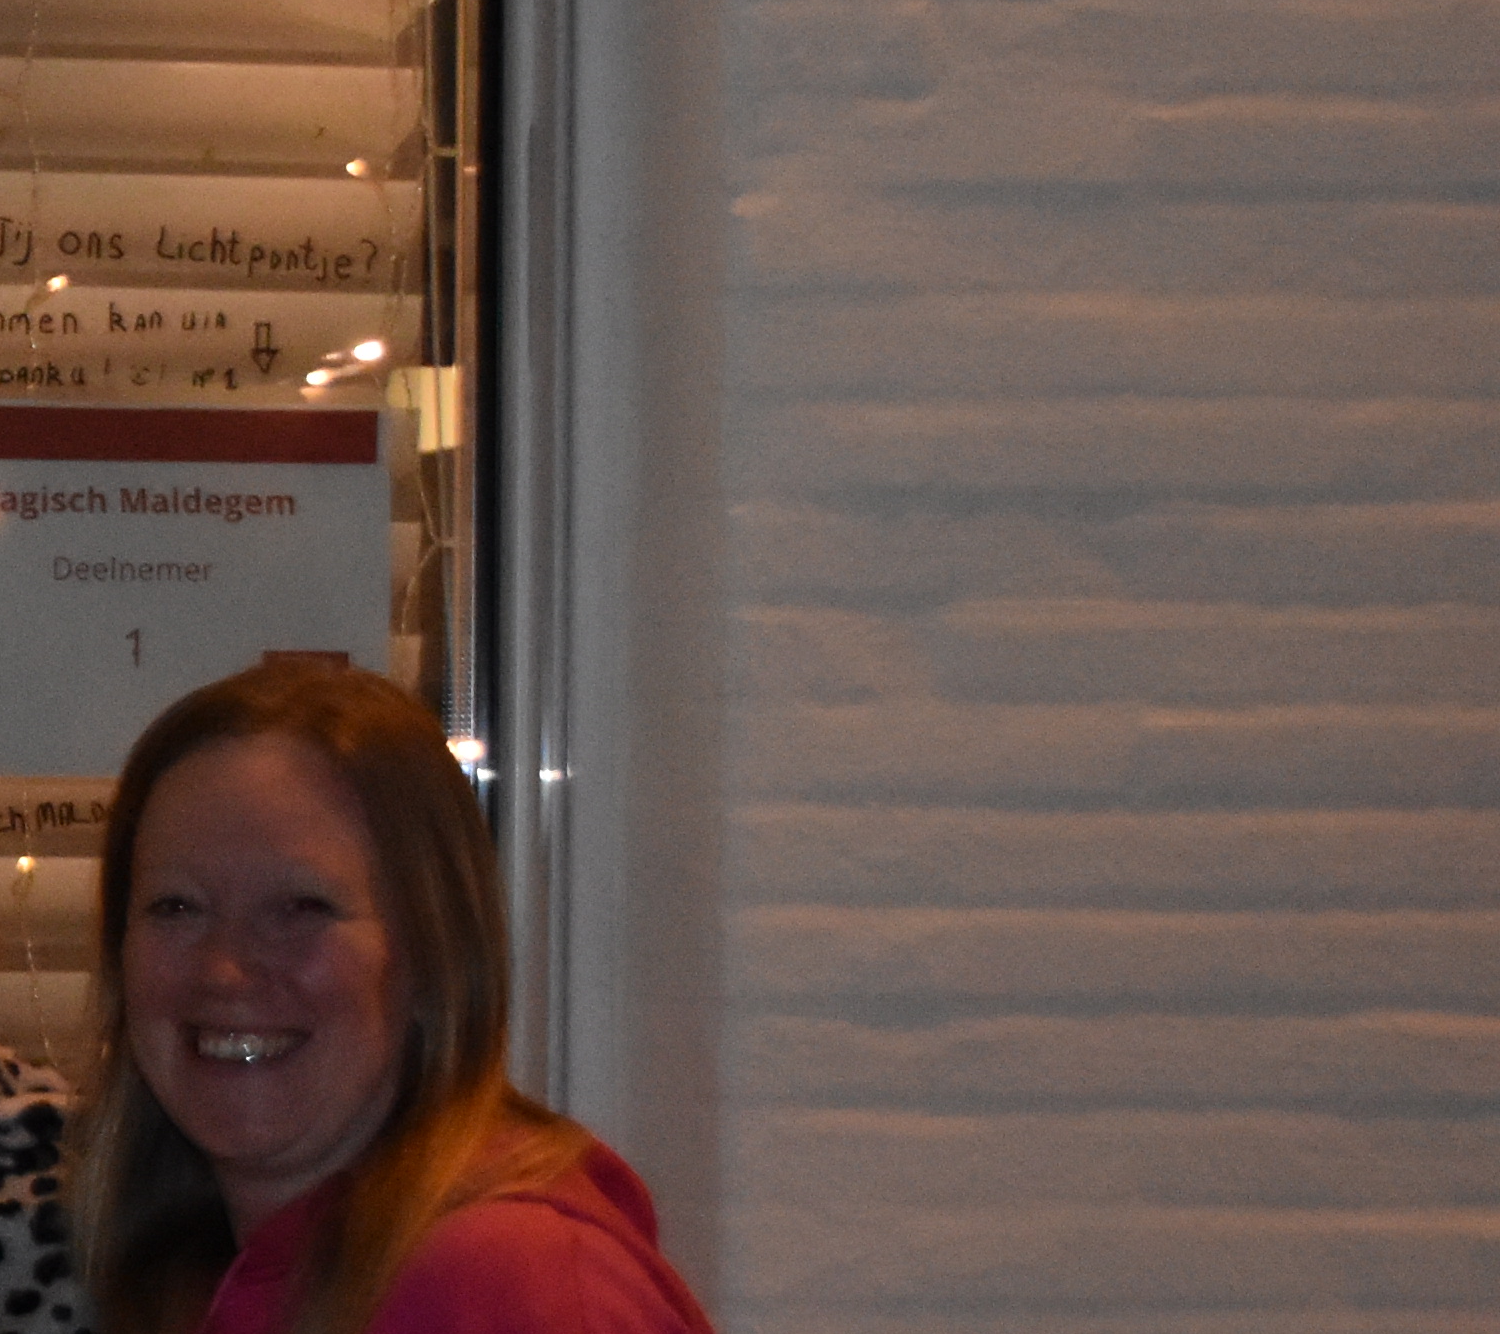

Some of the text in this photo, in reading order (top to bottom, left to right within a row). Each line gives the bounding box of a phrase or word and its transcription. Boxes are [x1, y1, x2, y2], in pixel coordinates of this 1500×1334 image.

[59, 230, 125, 260] ons
[119, 486, 297, 524] Maldegem
[52, 556, 213, 582] Deelnemer
[125, 627, 141, 668] 1
